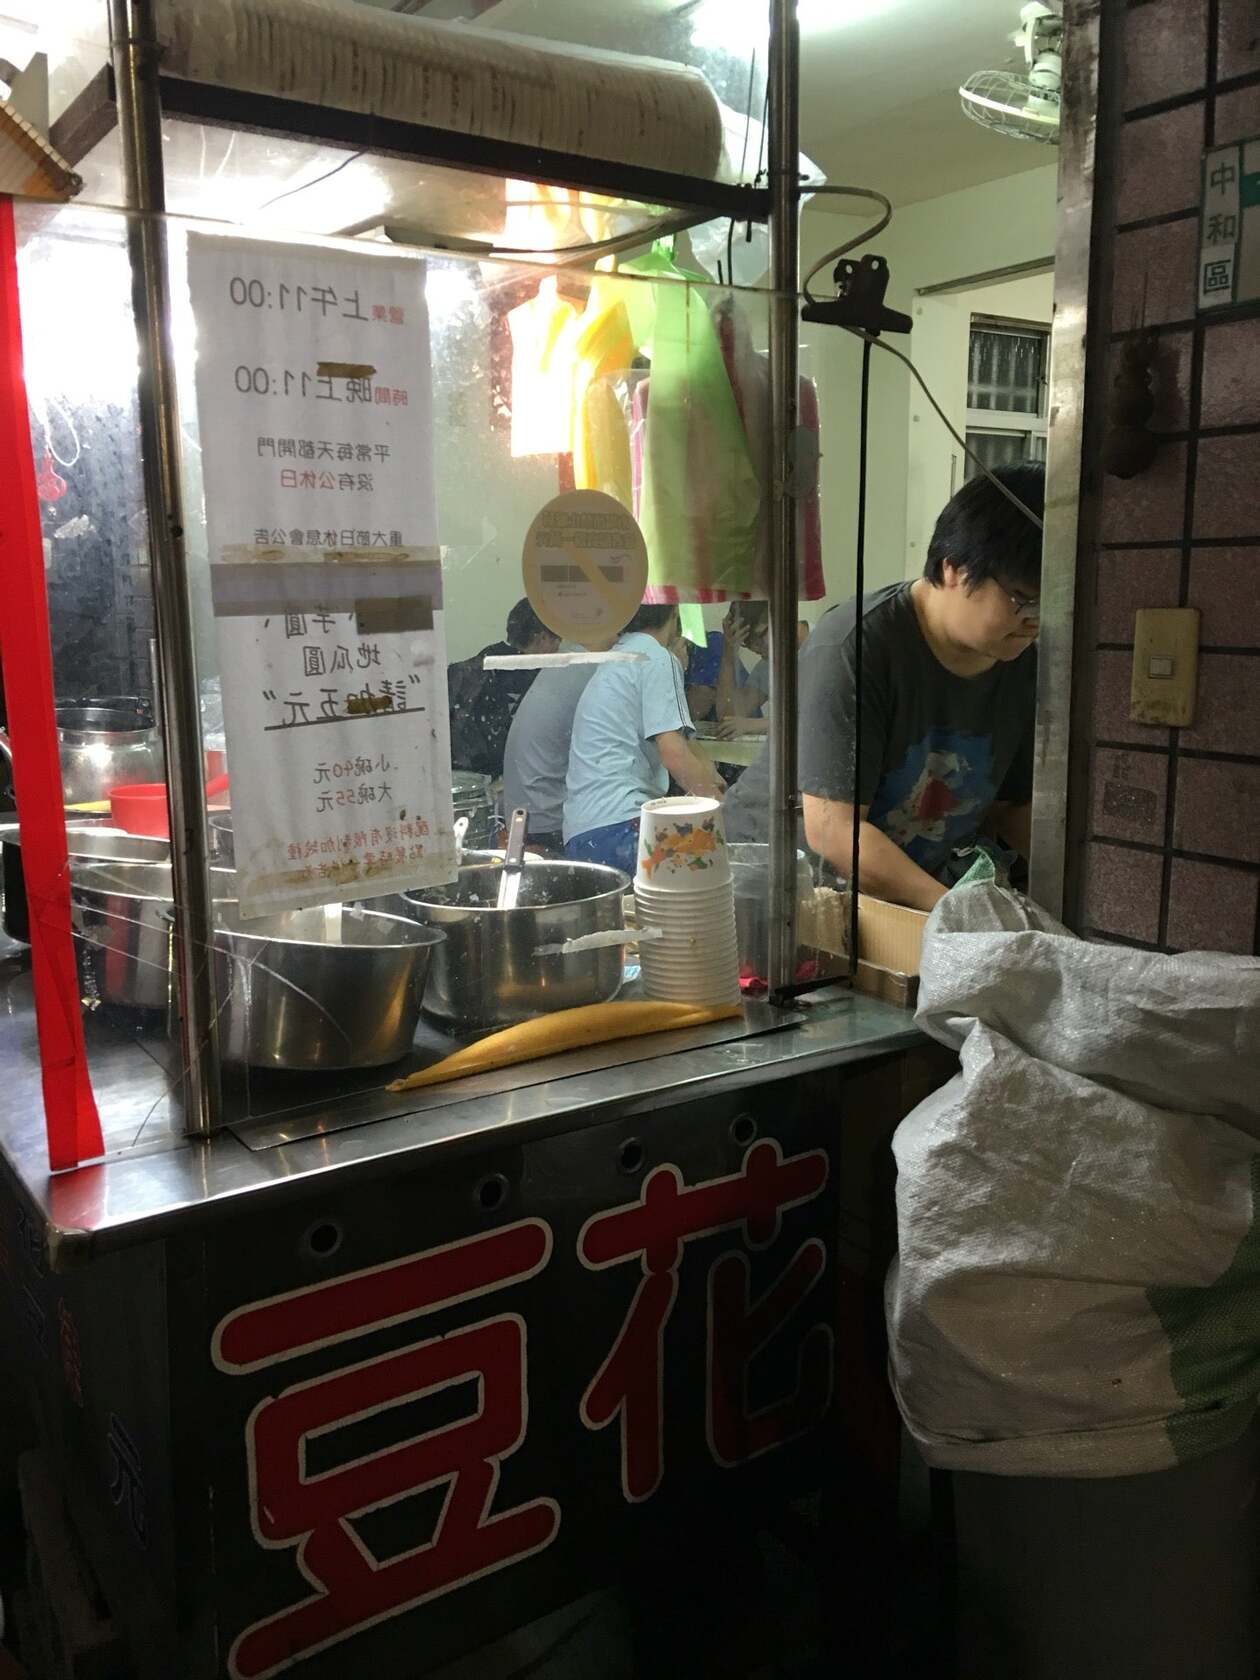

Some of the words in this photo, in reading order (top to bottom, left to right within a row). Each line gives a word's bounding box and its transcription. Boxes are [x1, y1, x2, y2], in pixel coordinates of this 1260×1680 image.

[1204, 162, 1236, 295] 中和區
[211, 1137, 834, 1680] 豆花
